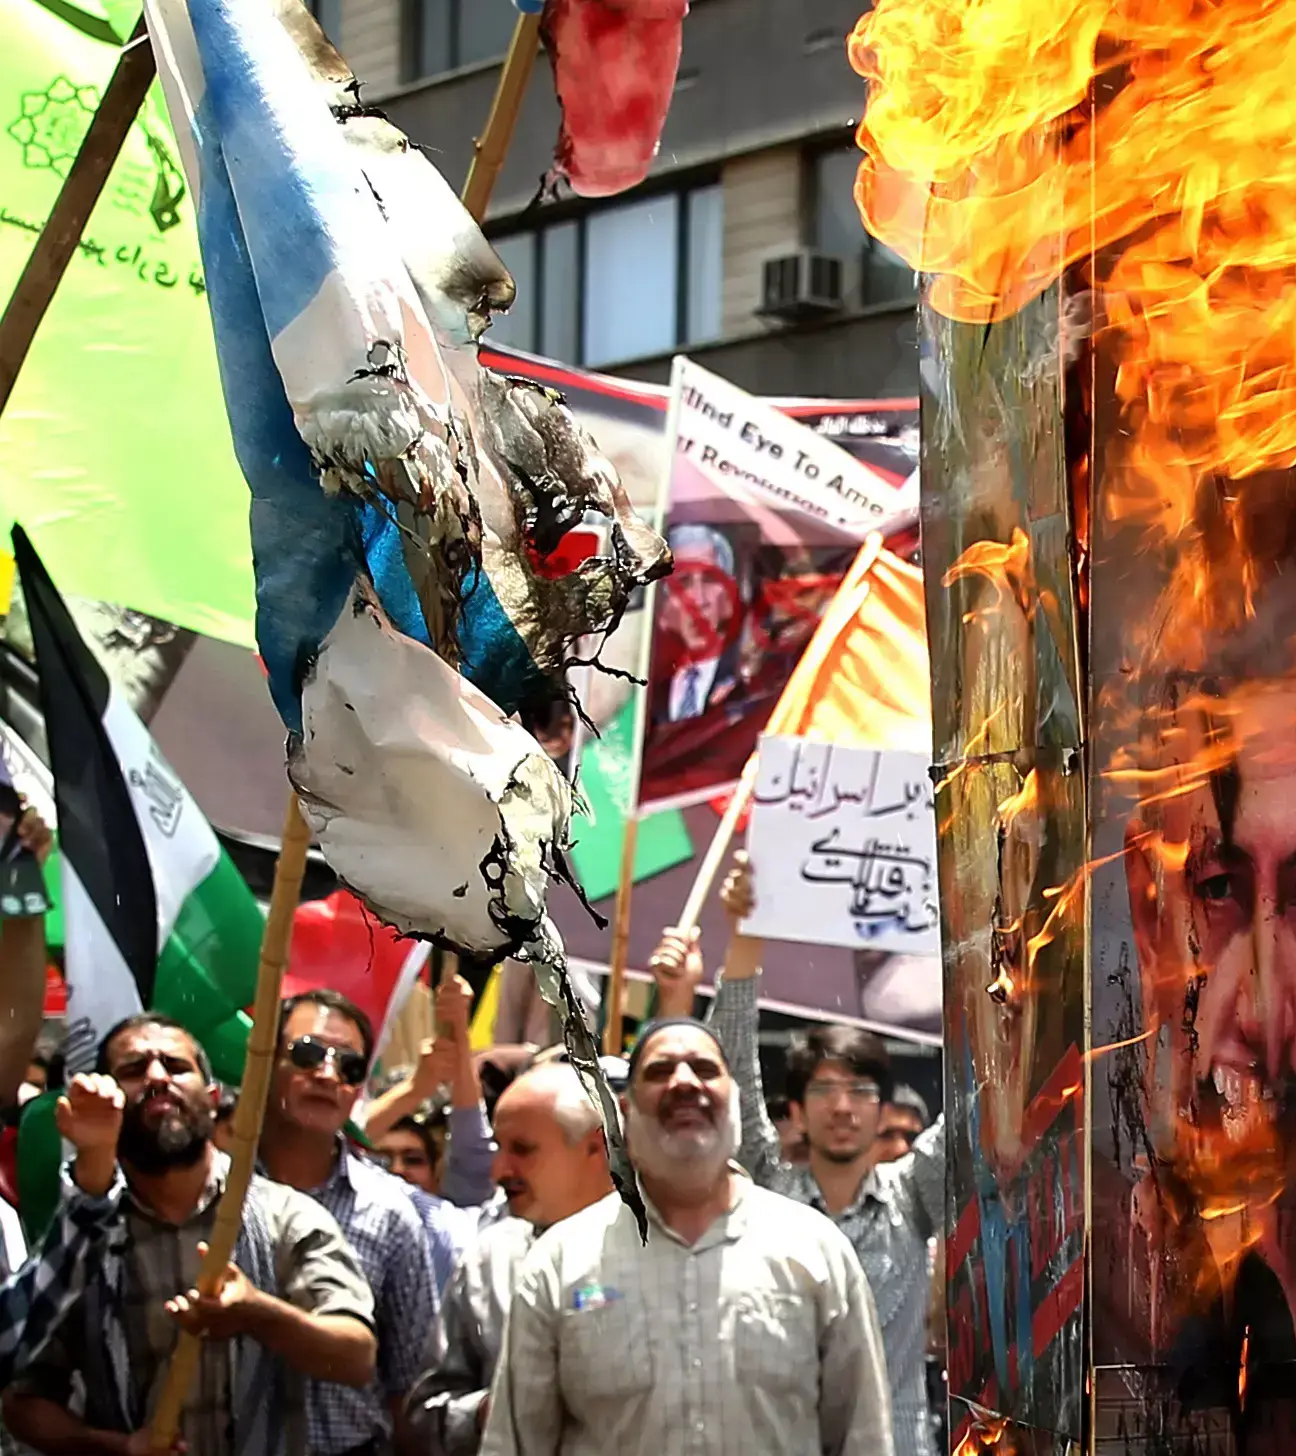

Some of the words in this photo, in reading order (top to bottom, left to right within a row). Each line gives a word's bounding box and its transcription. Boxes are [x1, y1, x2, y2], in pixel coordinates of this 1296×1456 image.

[740, 420, 783, 461] Eye
[794, 450, 821, 480] To
[825, 473, 885, 518] Ame
